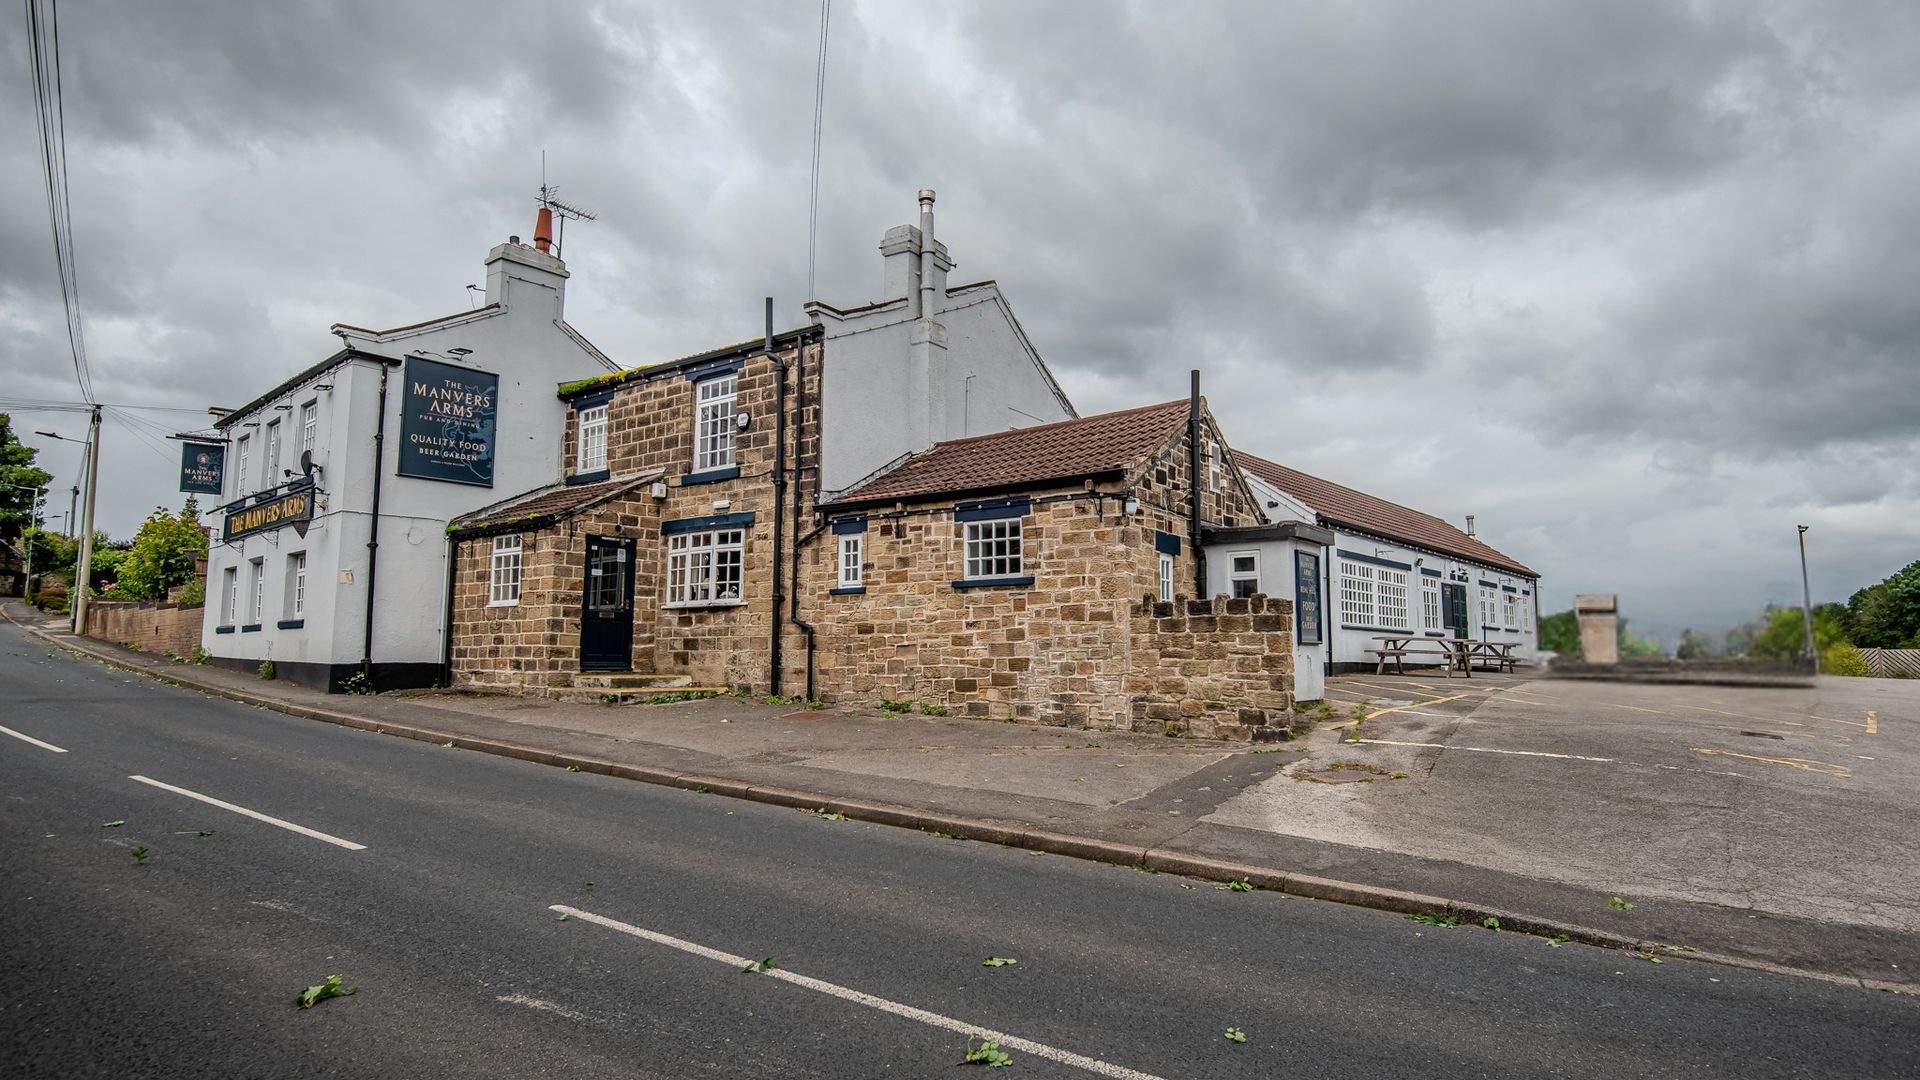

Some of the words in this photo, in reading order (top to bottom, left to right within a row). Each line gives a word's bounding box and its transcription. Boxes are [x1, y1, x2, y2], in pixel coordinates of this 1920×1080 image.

[445, 379, 462, 389] THE
[413, 382, 490, 407] MANVERS
[430, 400, 473, 418] ARMS
[455, 421, 481, 429] DINING
[410, 433, 455, 447] QUALITY
[460, 441, 486, 452] FOOD
[420, 448, 439, 456] BEER
[443, 450, 478, 461] GARDEN
[231, 516, 243, 533] THE
[245, 503, 280, 530] MANVERS
[282, 496, 305, 518] ARMS
[1303, 601, 1314, 611] FOOD
